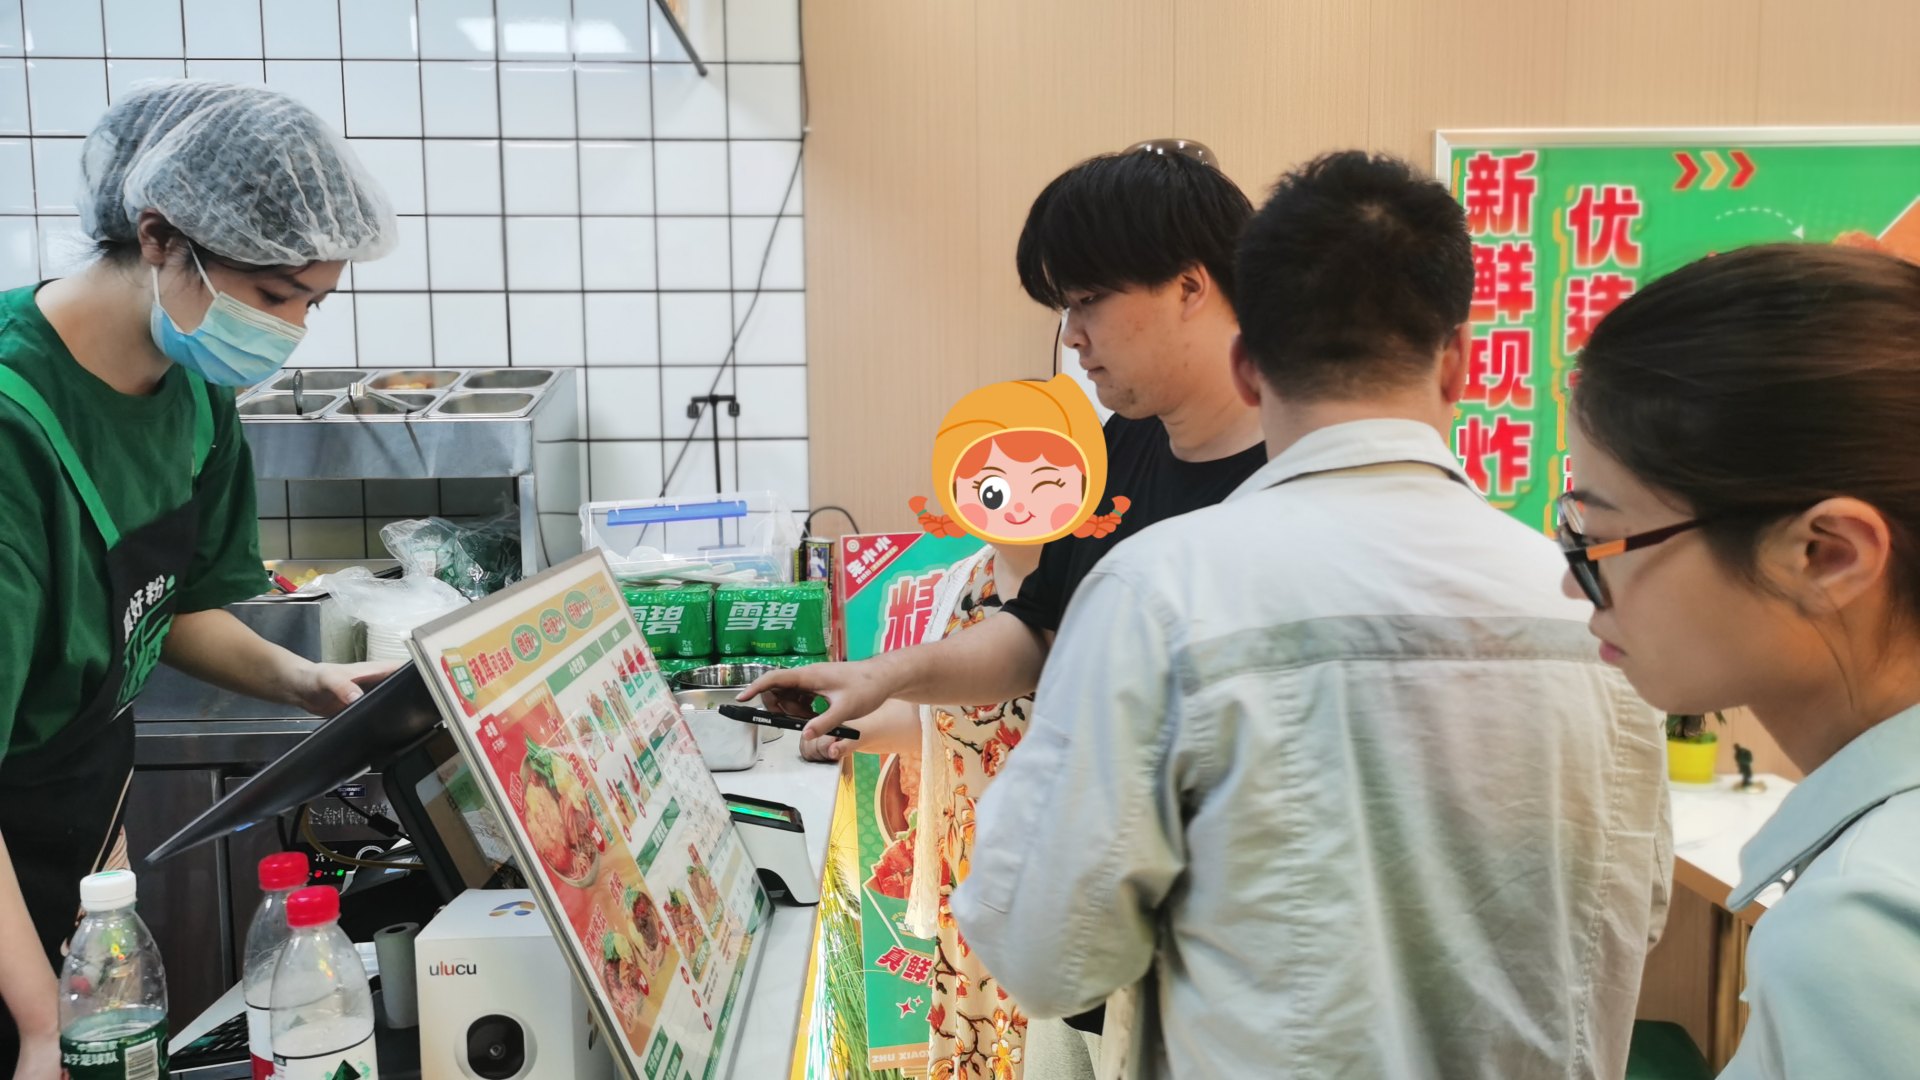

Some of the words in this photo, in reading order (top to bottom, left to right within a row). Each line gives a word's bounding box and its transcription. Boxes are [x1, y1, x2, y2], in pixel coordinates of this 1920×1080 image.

[1457, 151, 1537, 495] 新鲜现炸
[725, 601, 799, 631] 雪碧
[429, 962, 477, 977] ulucu
[876, 946, 934, 987] 真鲜
[871, 1054, 896, 1064] ZHU
